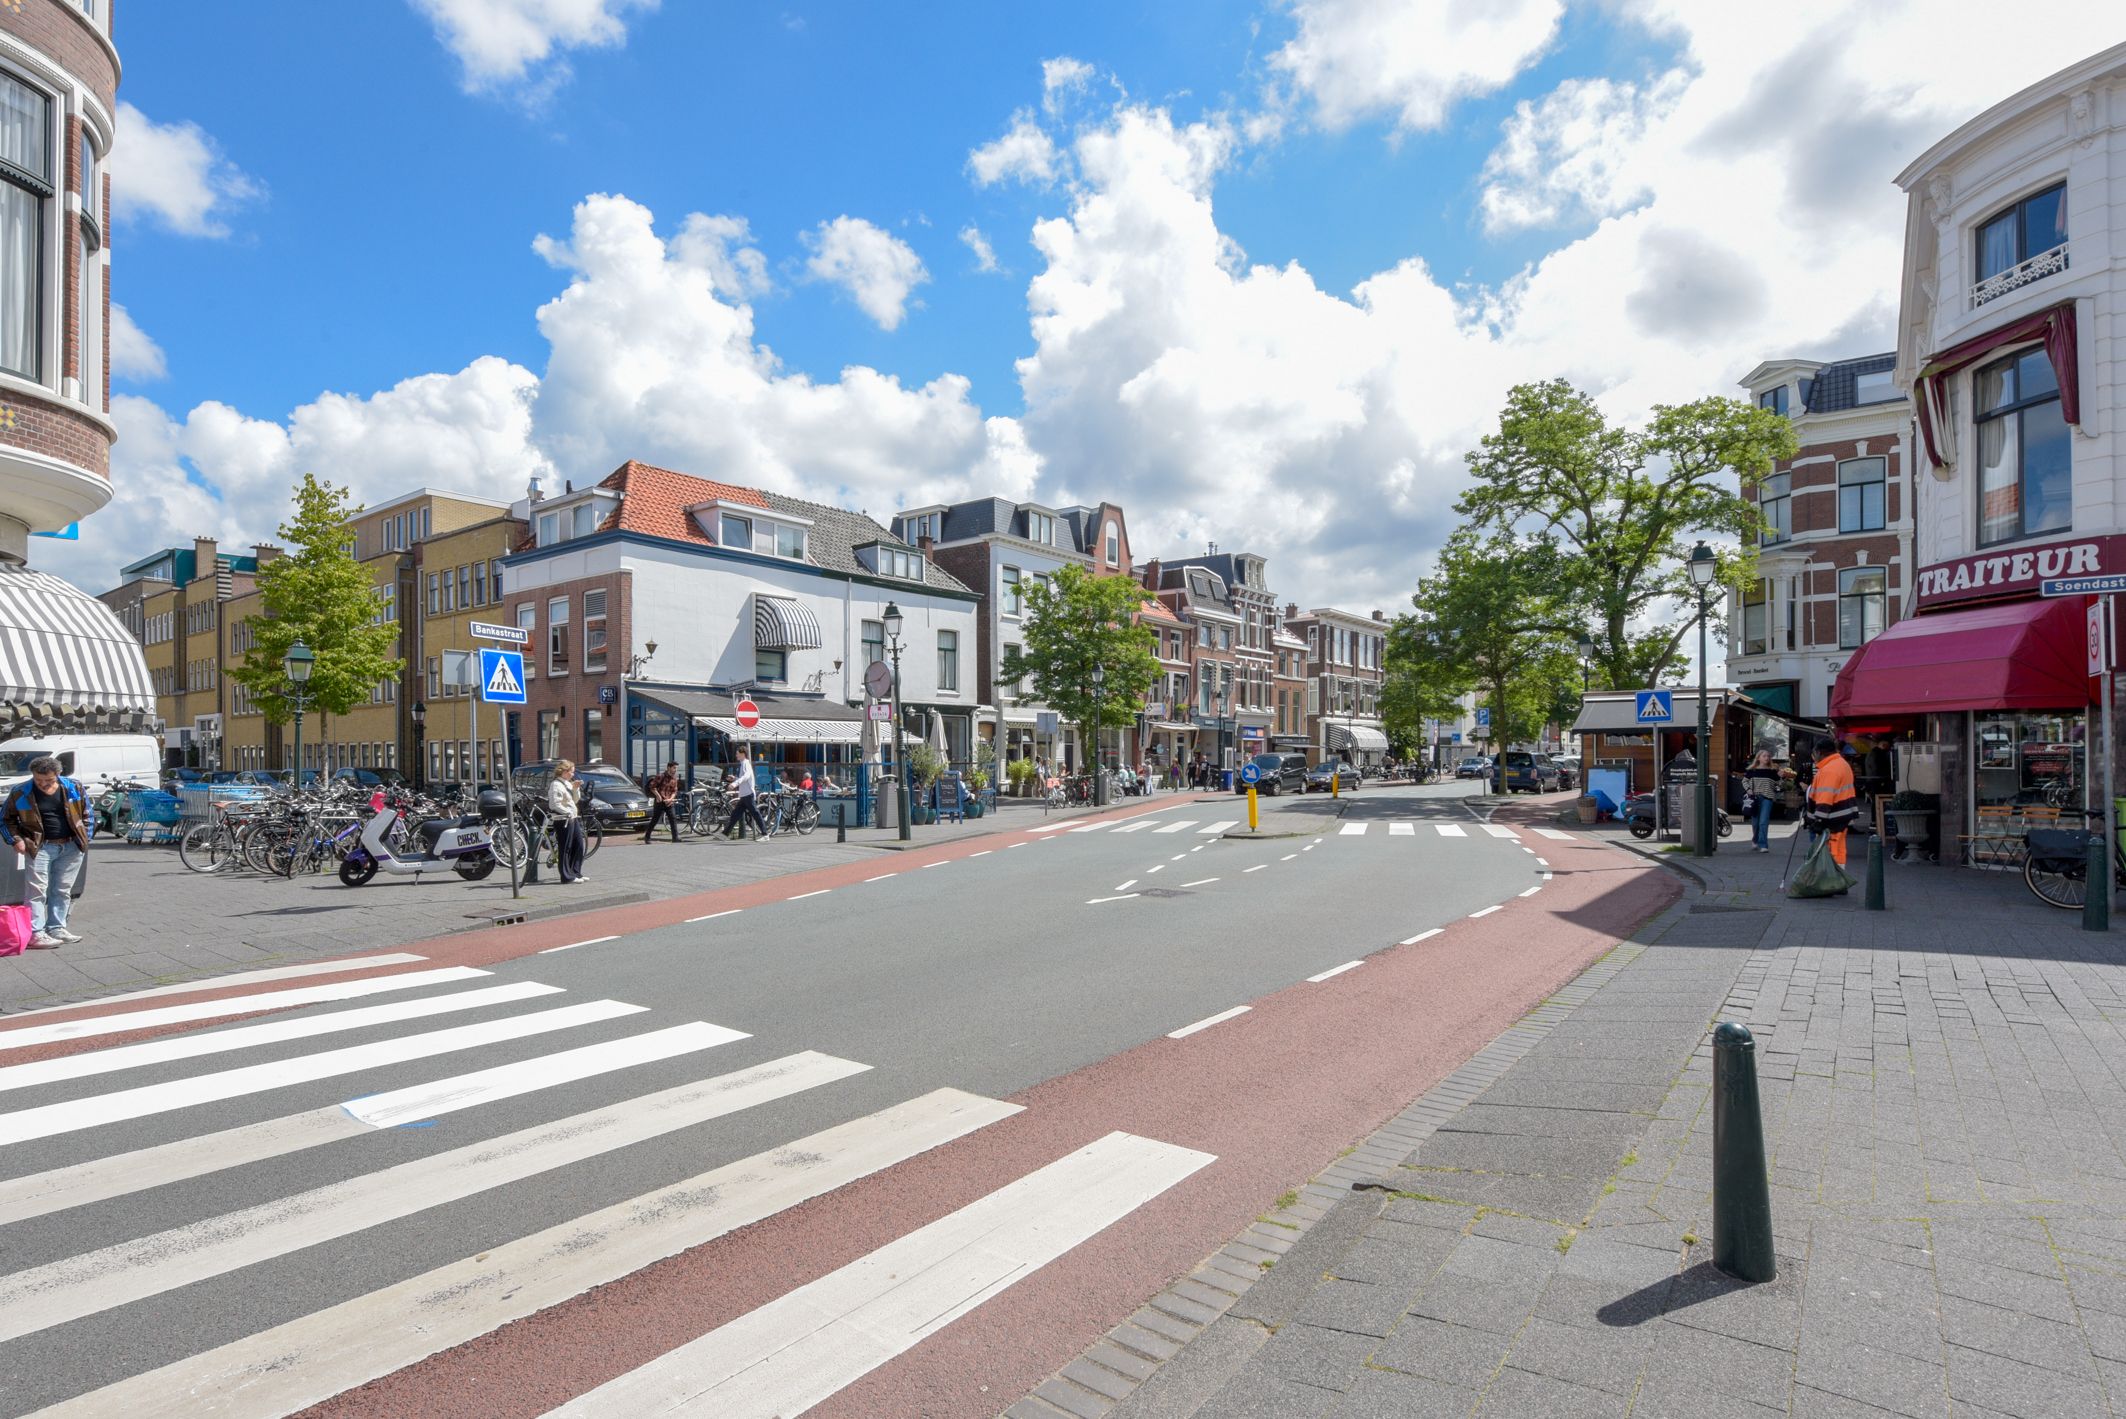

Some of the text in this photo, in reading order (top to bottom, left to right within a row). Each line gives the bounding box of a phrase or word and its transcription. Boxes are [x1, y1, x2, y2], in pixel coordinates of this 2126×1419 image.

[1919, 544, 2101, 597] TRAITEUR
[2054, 577, 2125, 591] Soendast
[475, 625, 523, 640] Bankastraat
